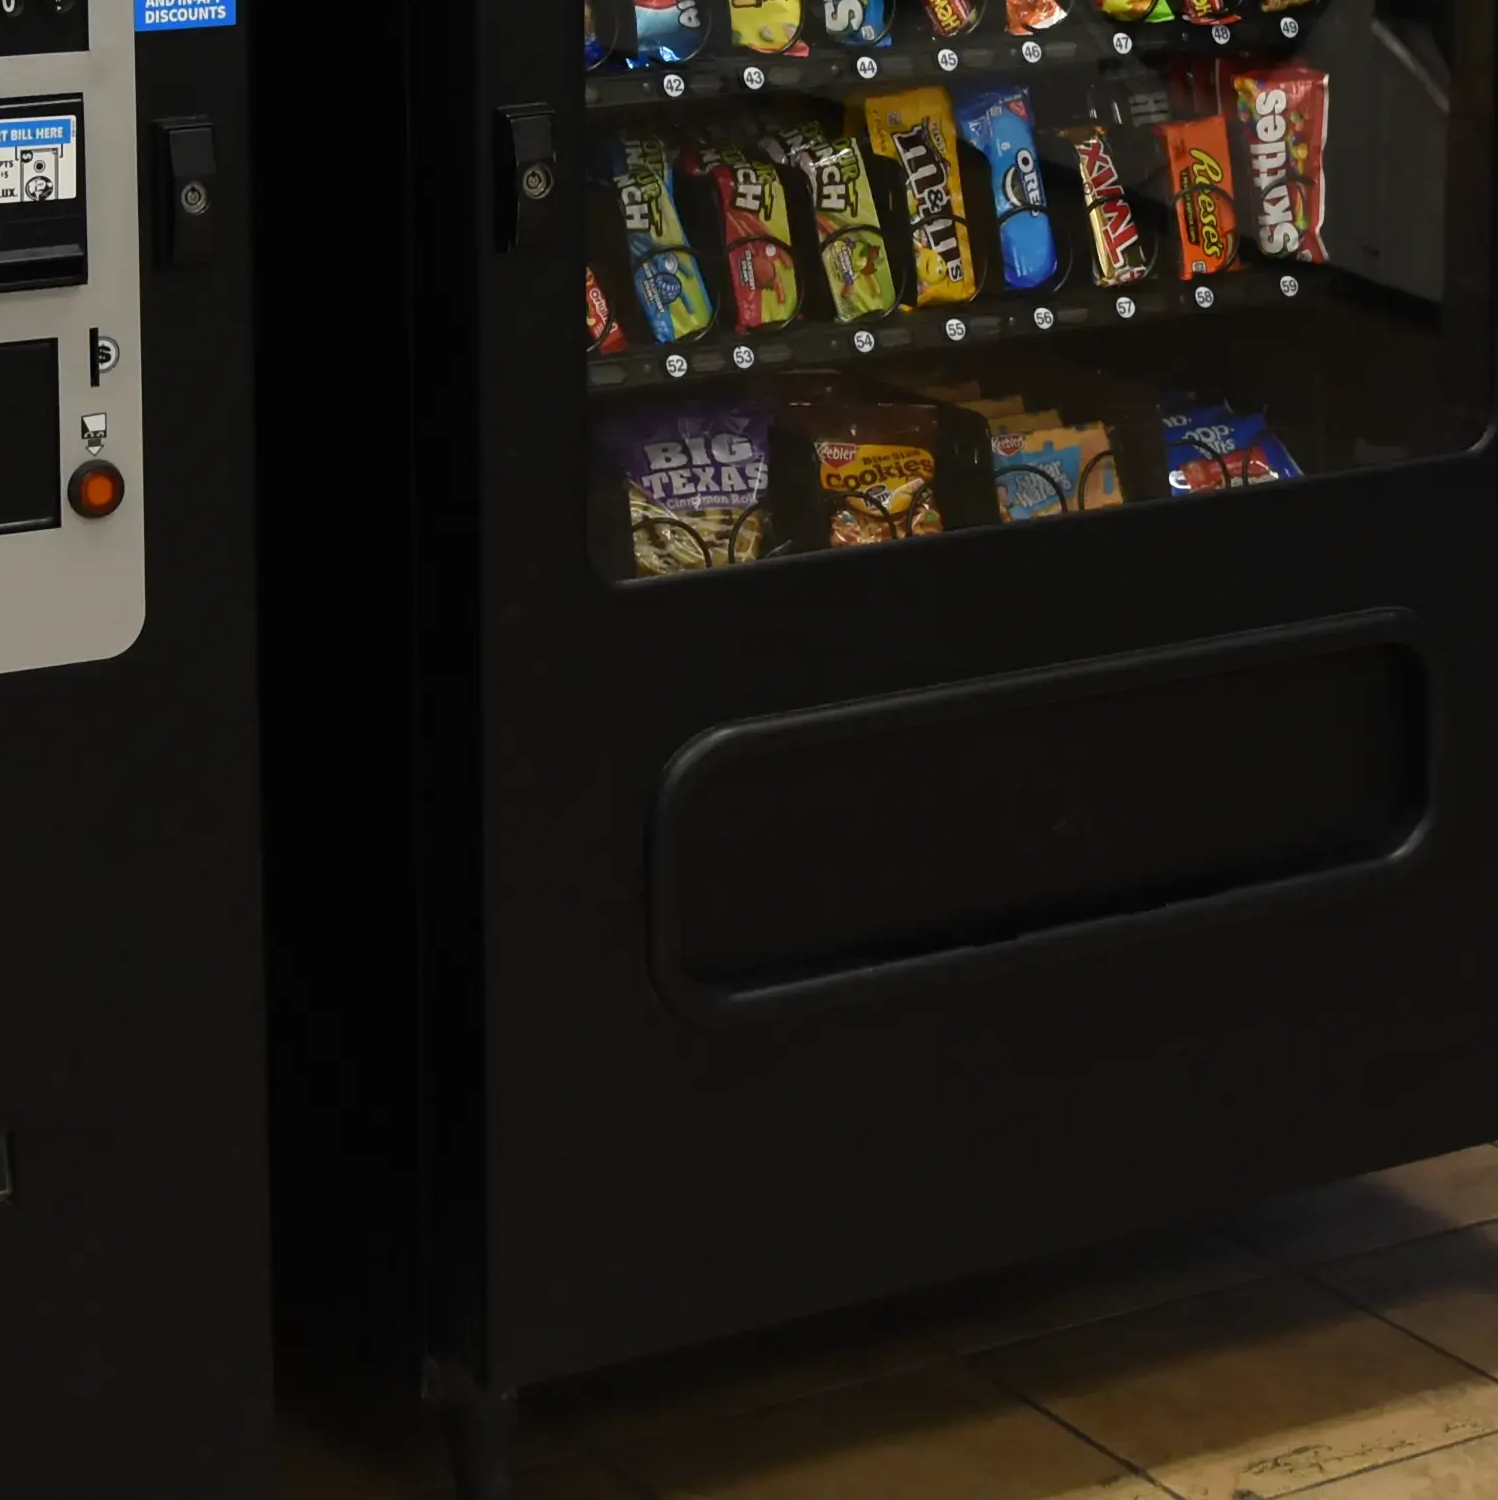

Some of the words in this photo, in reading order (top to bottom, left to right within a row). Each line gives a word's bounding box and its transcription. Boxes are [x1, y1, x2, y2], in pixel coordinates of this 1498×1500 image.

[144, 5, 227, 24] DISCOUNTS
[1213, 27, 1229, 41] 48
[1281, 21, 1298, 35] 49
[1114, 37, 1130, 50] 47
[1023, 45, 1040, 59] 46
[858, 60, 876, 74] 44
[940, 53, 957, 67] 45
[746, 70, 762, 84] 43
[665, 79, 683, 92] 42
[10, 128, 33, 141] BILL
[35, 126, 64, 139] HERE
[1075, 138, 1139, 268] TWIX
[1281, 280, 1297, 293] 59
[1196, 291, 1212, 303] 58
[1117, 301, 1133, 314] 57
[1035, 311, 1052, 325] 56
[947, 323, 964, 336] 55
[856, 334, 873, 348] 54
[735, 350, 752, 364] 53
[668, 359, 685, 373] 52
[643, 433, 752, 471] BIG
[862, 453, 890, 467] Bite
[892, 448, 921, 461] Size
[826, 456, 935, 492] Cookies
[642, 463, 769, 500] TEXAS
